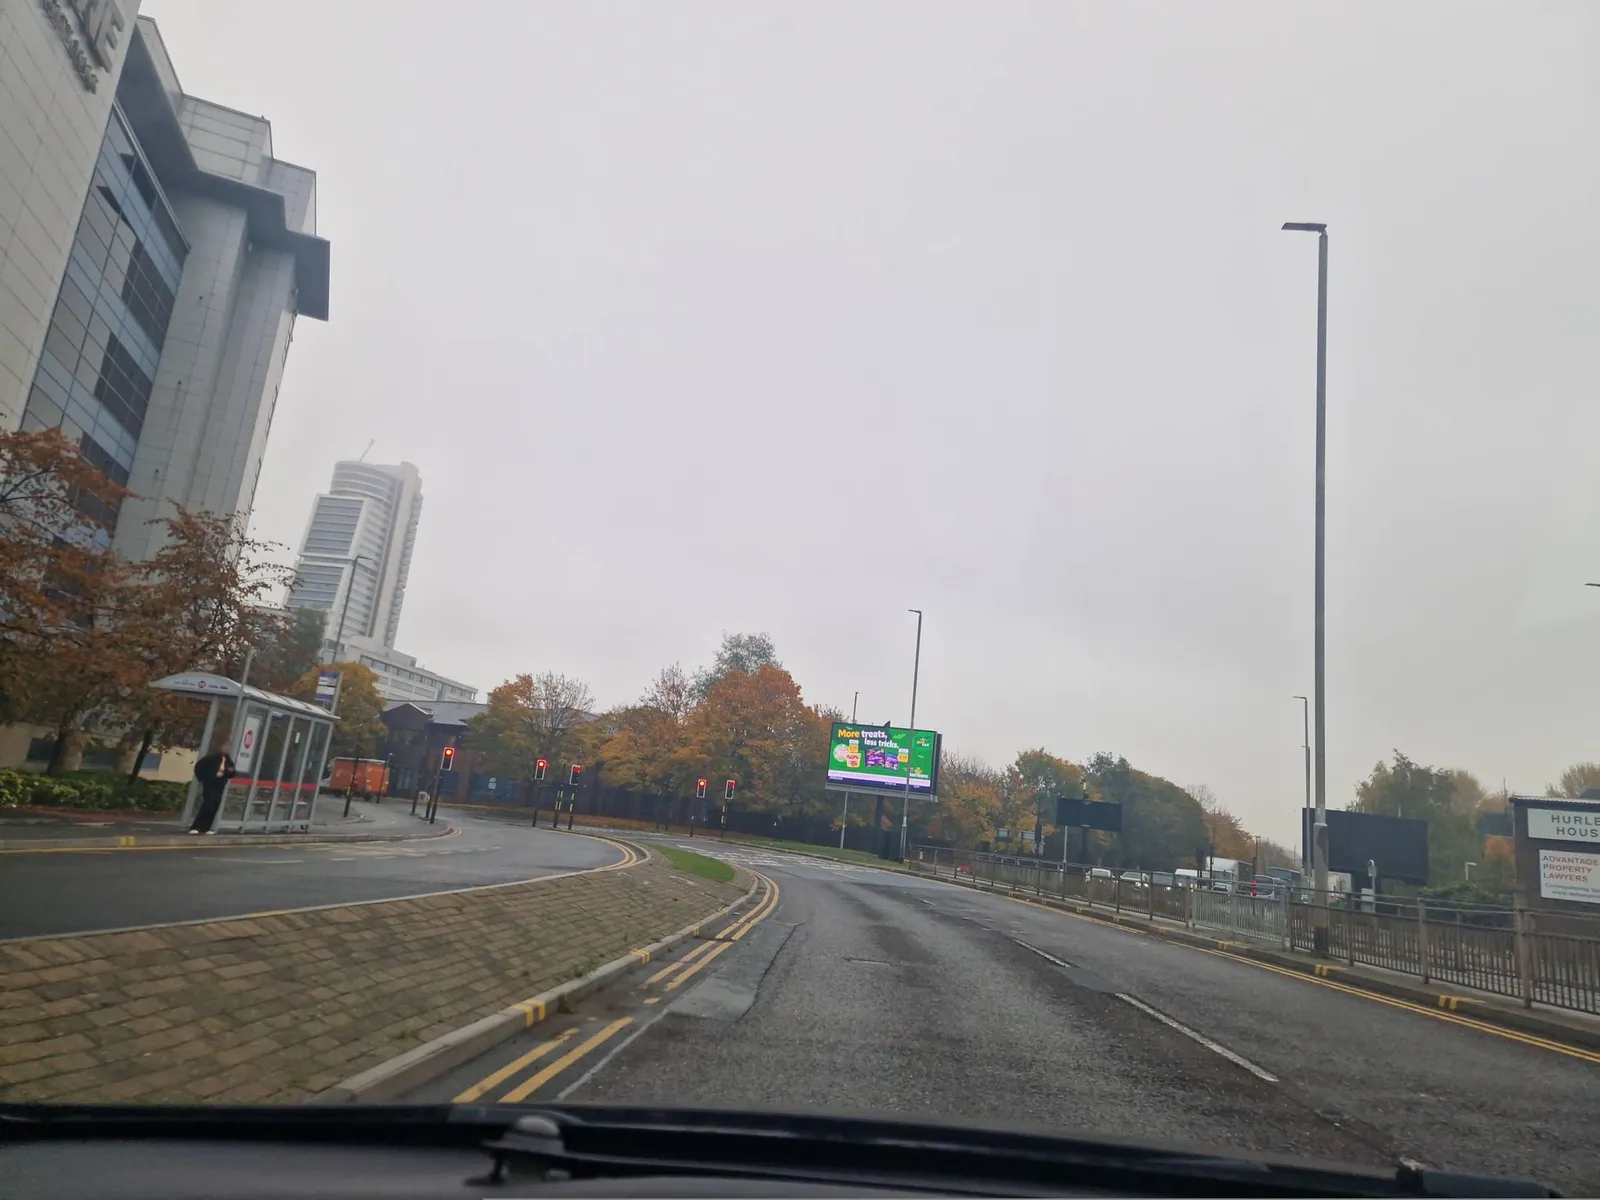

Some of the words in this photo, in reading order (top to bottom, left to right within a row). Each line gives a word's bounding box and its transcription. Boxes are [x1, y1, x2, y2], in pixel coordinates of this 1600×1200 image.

[838, 729, 860, 738] More
[861, 730, 888, 739] treats,
[864, 738, 877, 747] less
[878, 739, 899, 749] tricks.
[1551, 814, 1600, 826] HURLE
[1556, 826, 1599, 838] HOUS
[1543, 855, 1600, 867] ADVANTAGE
[1543, 863, 1592, 874] PROPERTY
[1543, 872, 1589, 882] LAWYERS
